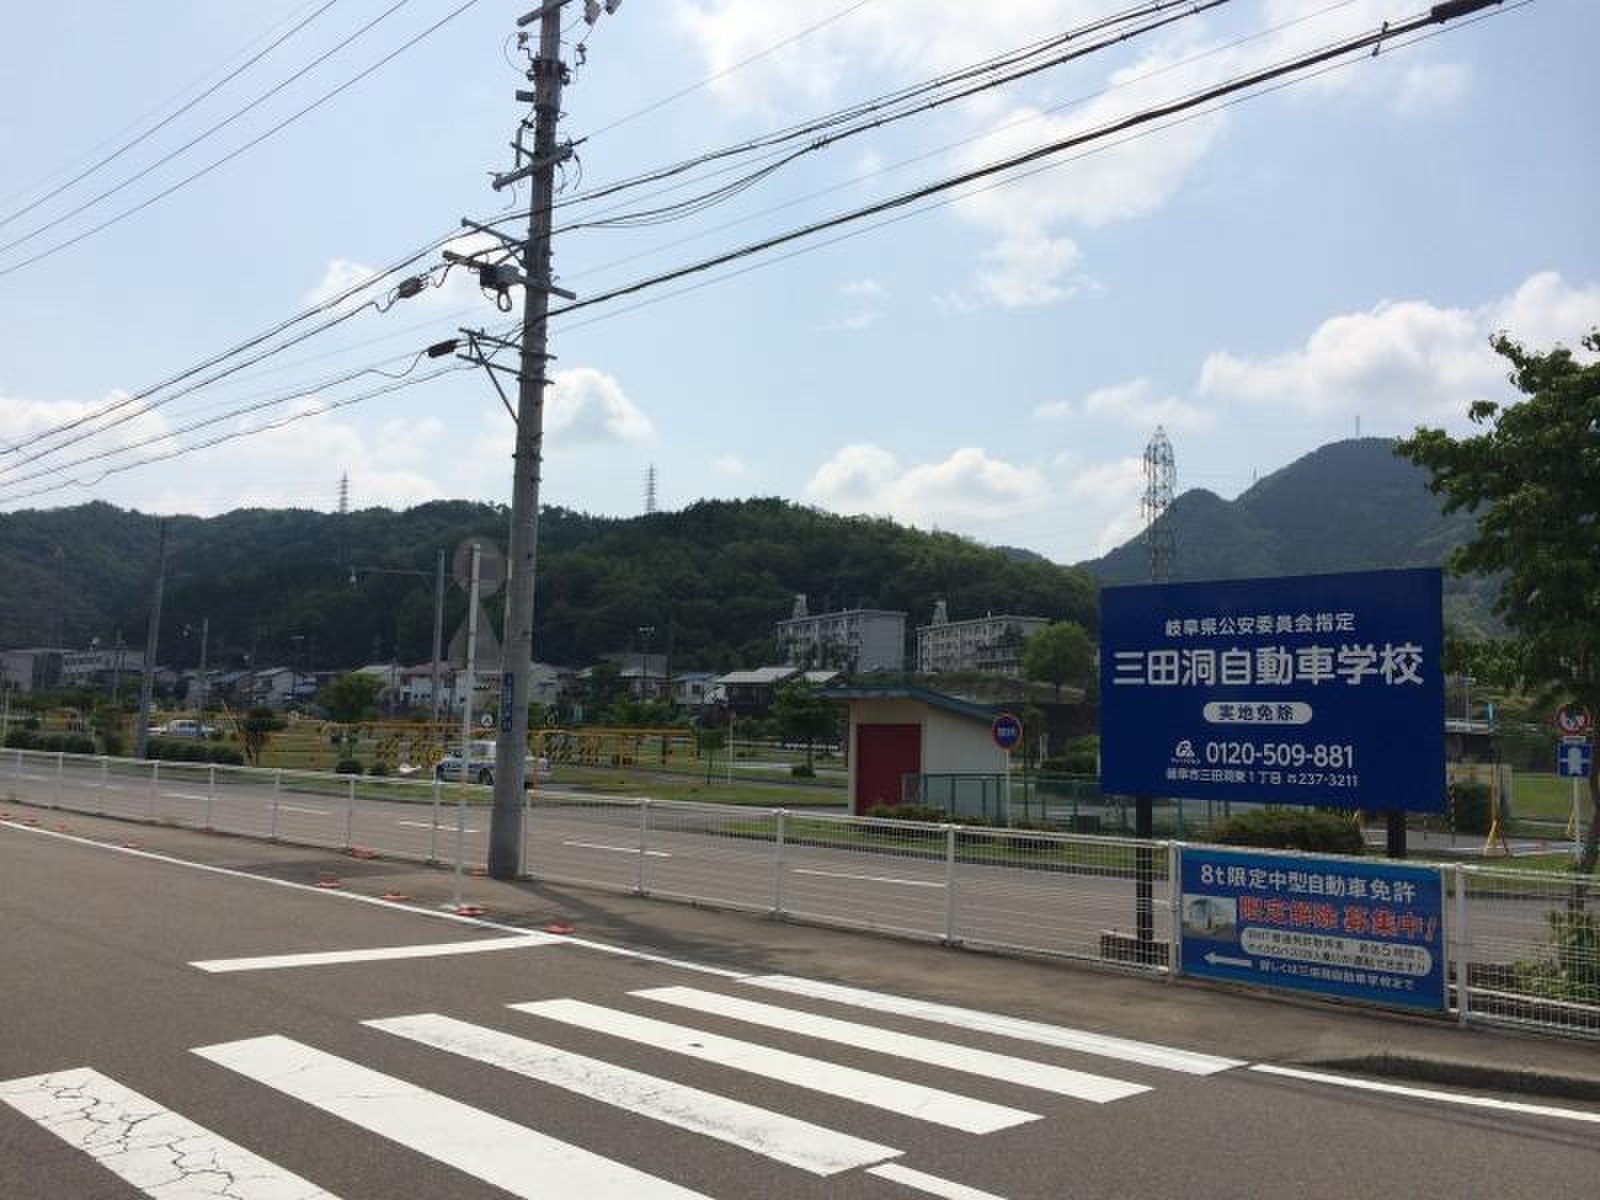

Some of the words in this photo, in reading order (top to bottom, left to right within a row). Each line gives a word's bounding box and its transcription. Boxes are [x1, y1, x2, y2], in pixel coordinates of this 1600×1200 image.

[1165, 612, 1355, 637] 岐阜県公安委員会指定
[1112, 642, 1425, 687] 三田洞自動車学校
[1218, 703, 1295, 722] 実地免除
[1205, 741, 1354, 768] 0120-509-881
[1199, 863, 1417, 905] 8t限定中型自動車免許
